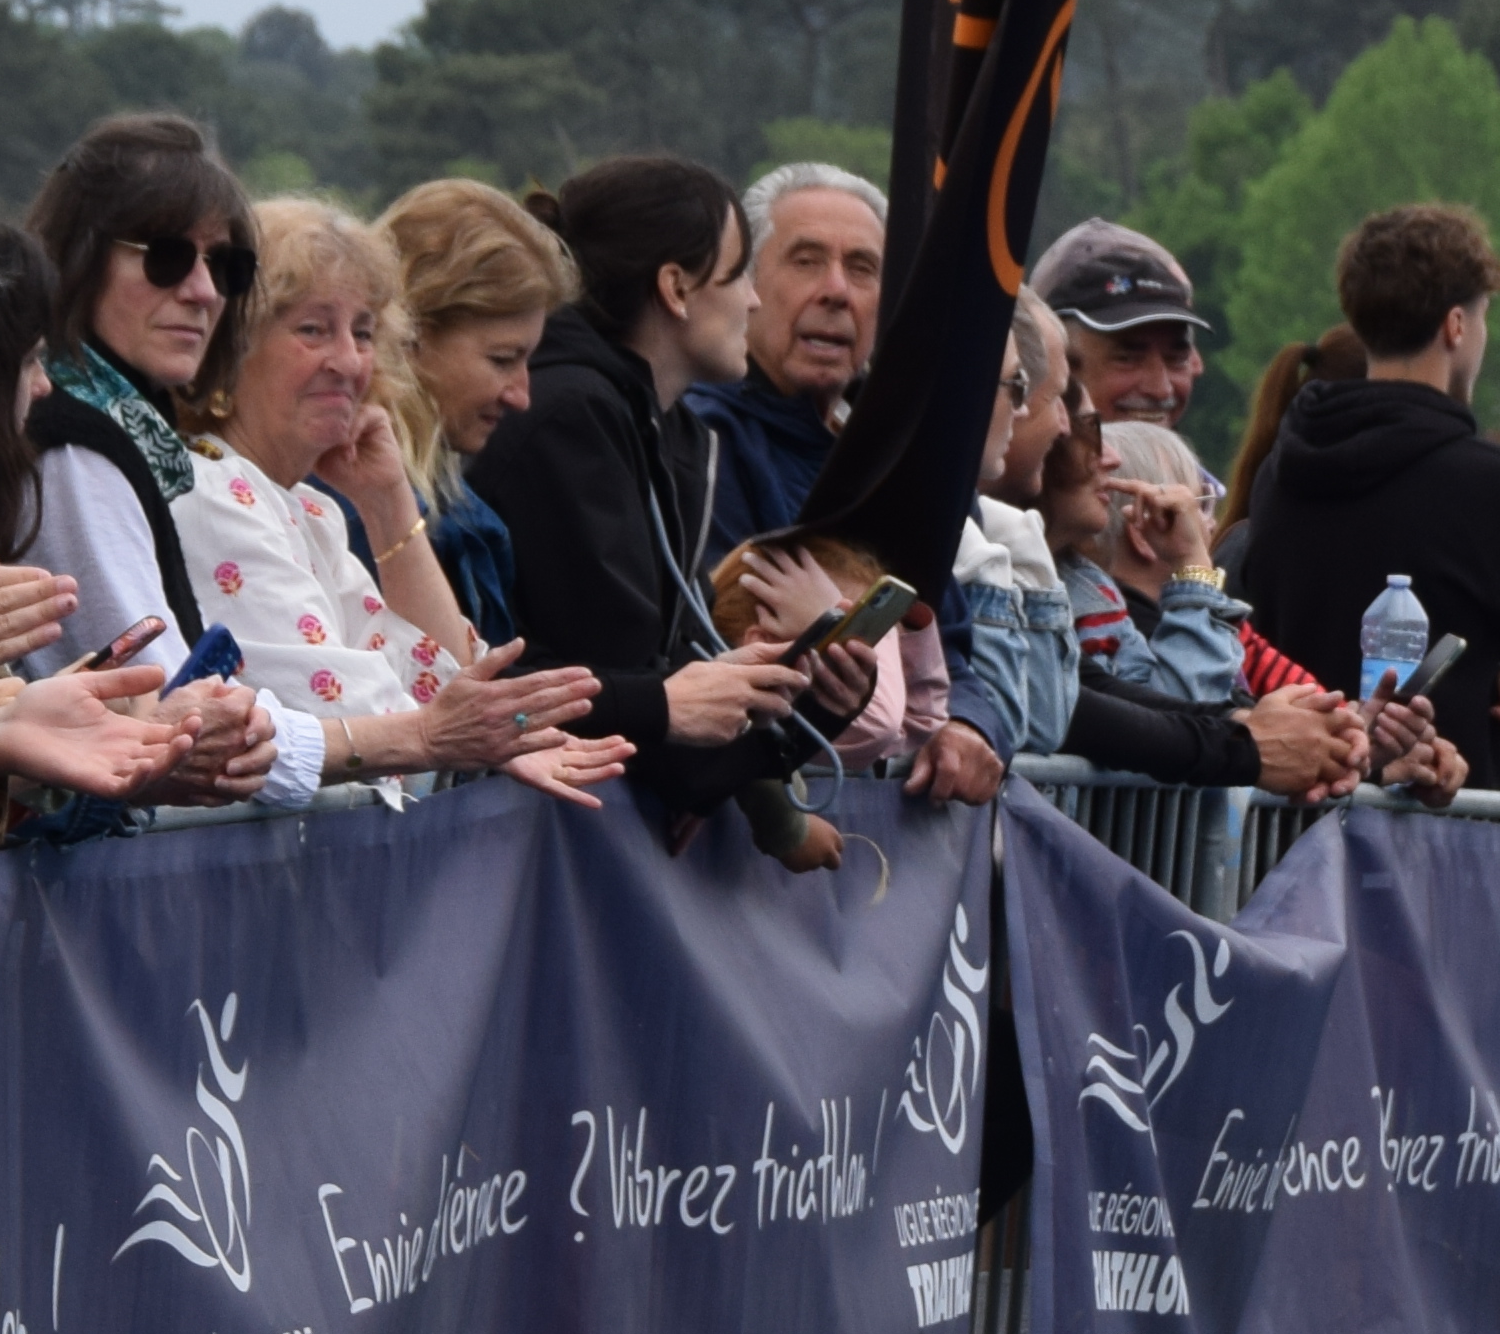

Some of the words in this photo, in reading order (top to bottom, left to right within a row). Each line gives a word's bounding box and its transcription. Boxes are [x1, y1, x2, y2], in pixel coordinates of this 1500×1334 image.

[569, 1110, 597, 1243] ?
[606, 1105, 736, 1235] Vibrez
[318, 1183, 424, 1314] Envie
